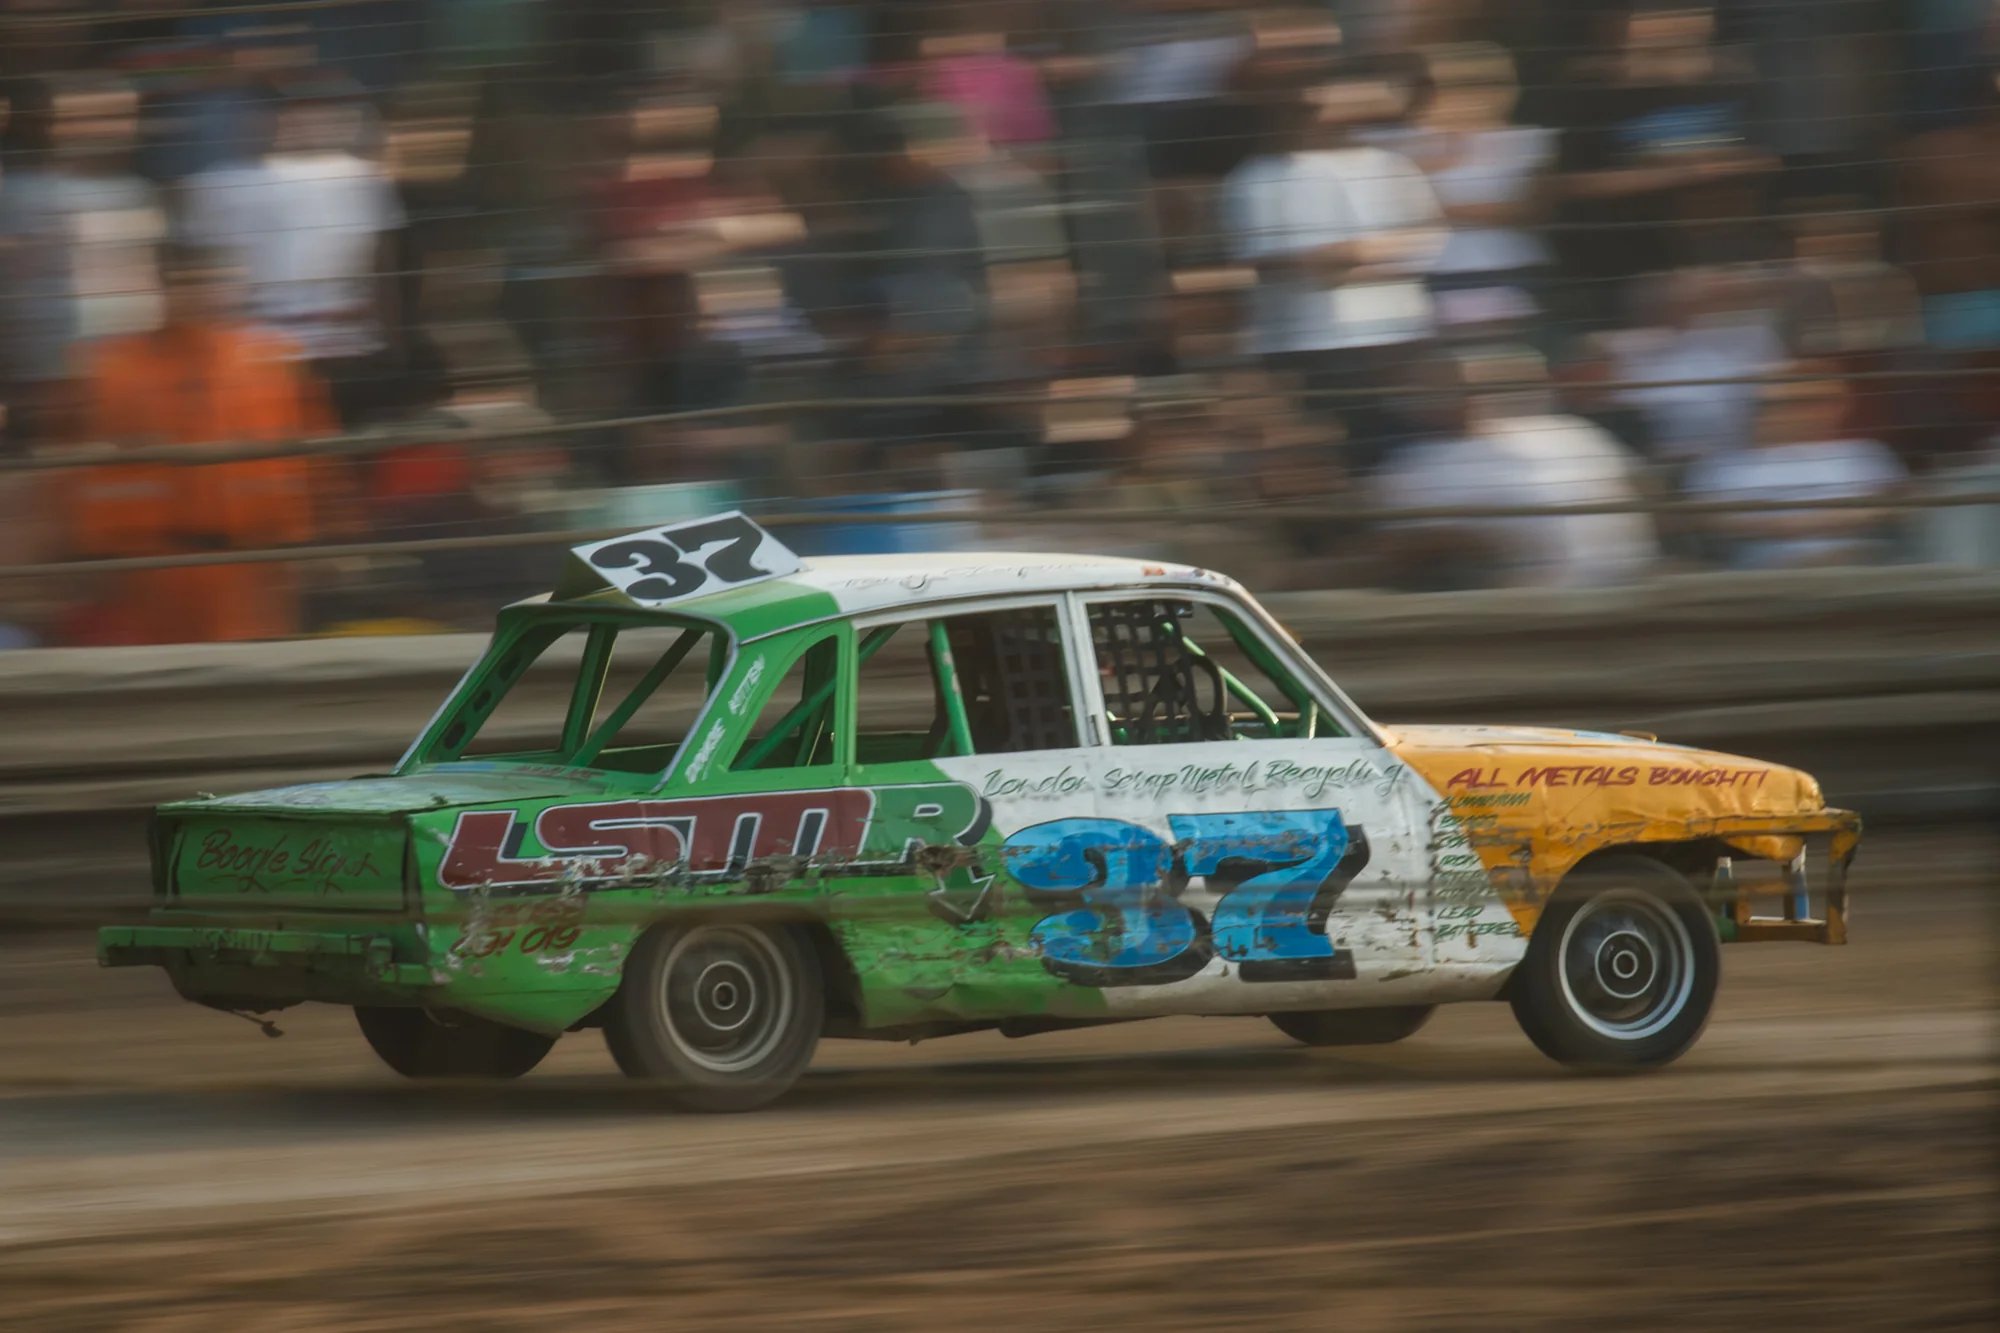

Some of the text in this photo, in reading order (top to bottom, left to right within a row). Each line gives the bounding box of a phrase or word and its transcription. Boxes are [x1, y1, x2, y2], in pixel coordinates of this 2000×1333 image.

[590, 515, 775, 601] 37
[983, 765, 1093, 798] London
[1101, 767, 1179, 803] Scrap
[1179, 760, 1260, 794] Metal
[1447, 766, 1768, 790] ALL METALS BOUGHT!
[1001, 807, 1350, 970] 37
[1437, 905, 1485, 920] LEAD
